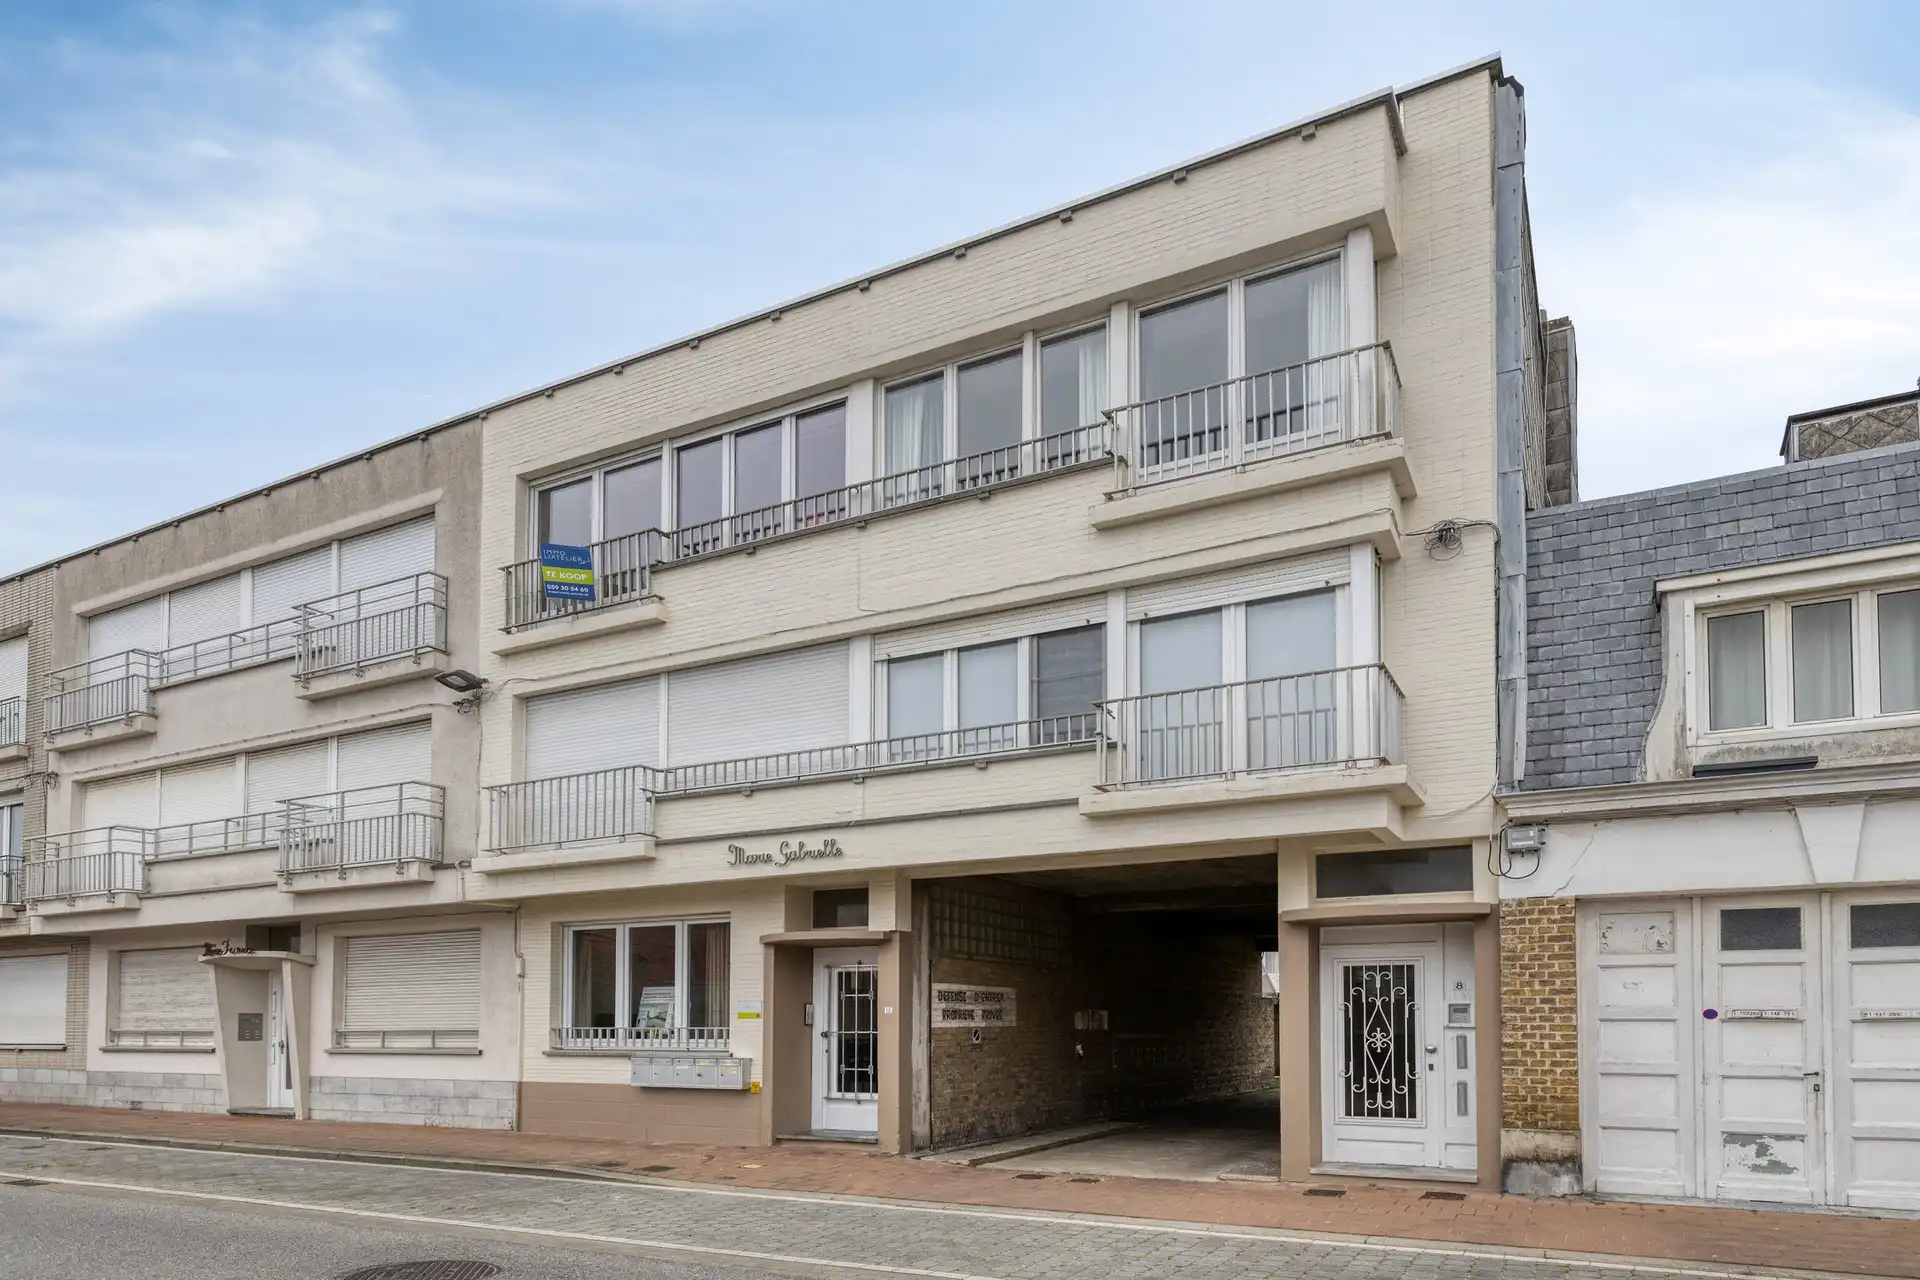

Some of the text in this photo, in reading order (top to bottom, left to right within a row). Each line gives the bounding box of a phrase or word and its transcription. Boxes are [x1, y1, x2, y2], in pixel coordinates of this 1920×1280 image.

[546, 570, 588, 580] TE KOOP
[727, 838, 844, 867] Marie Gabrielle
[1455, 981, 1464, 990] 8
